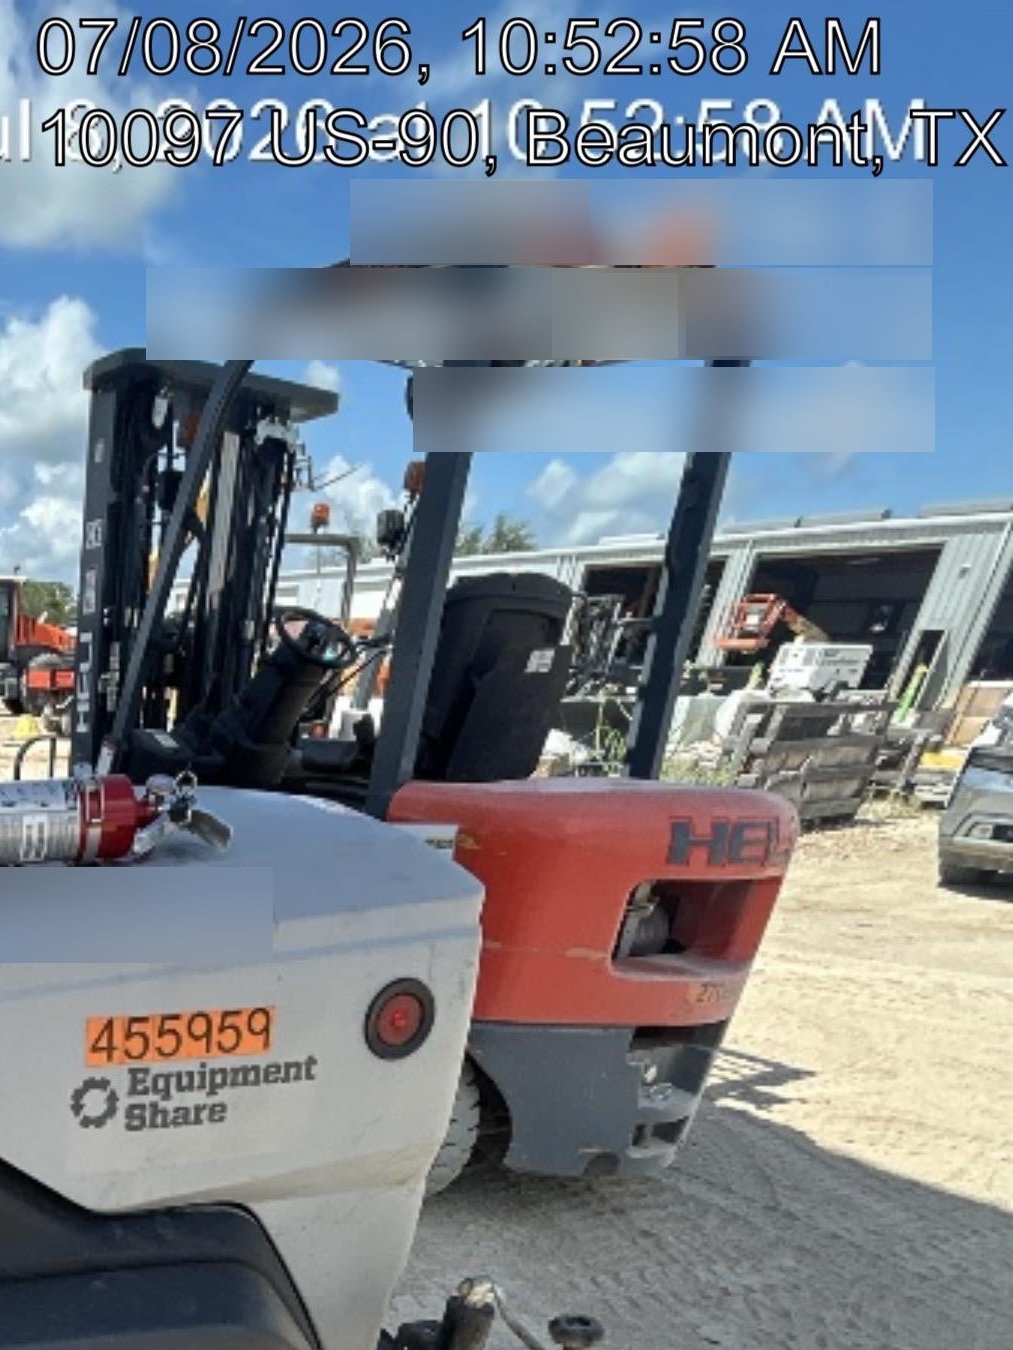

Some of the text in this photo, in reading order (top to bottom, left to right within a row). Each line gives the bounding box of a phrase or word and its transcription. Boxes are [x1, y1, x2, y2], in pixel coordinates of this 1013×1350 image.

[90, 1006, 272, 1062] 455959
[127, 1055, 318, 1101] Equipment
[124, 1100, 228, 1132] Share
